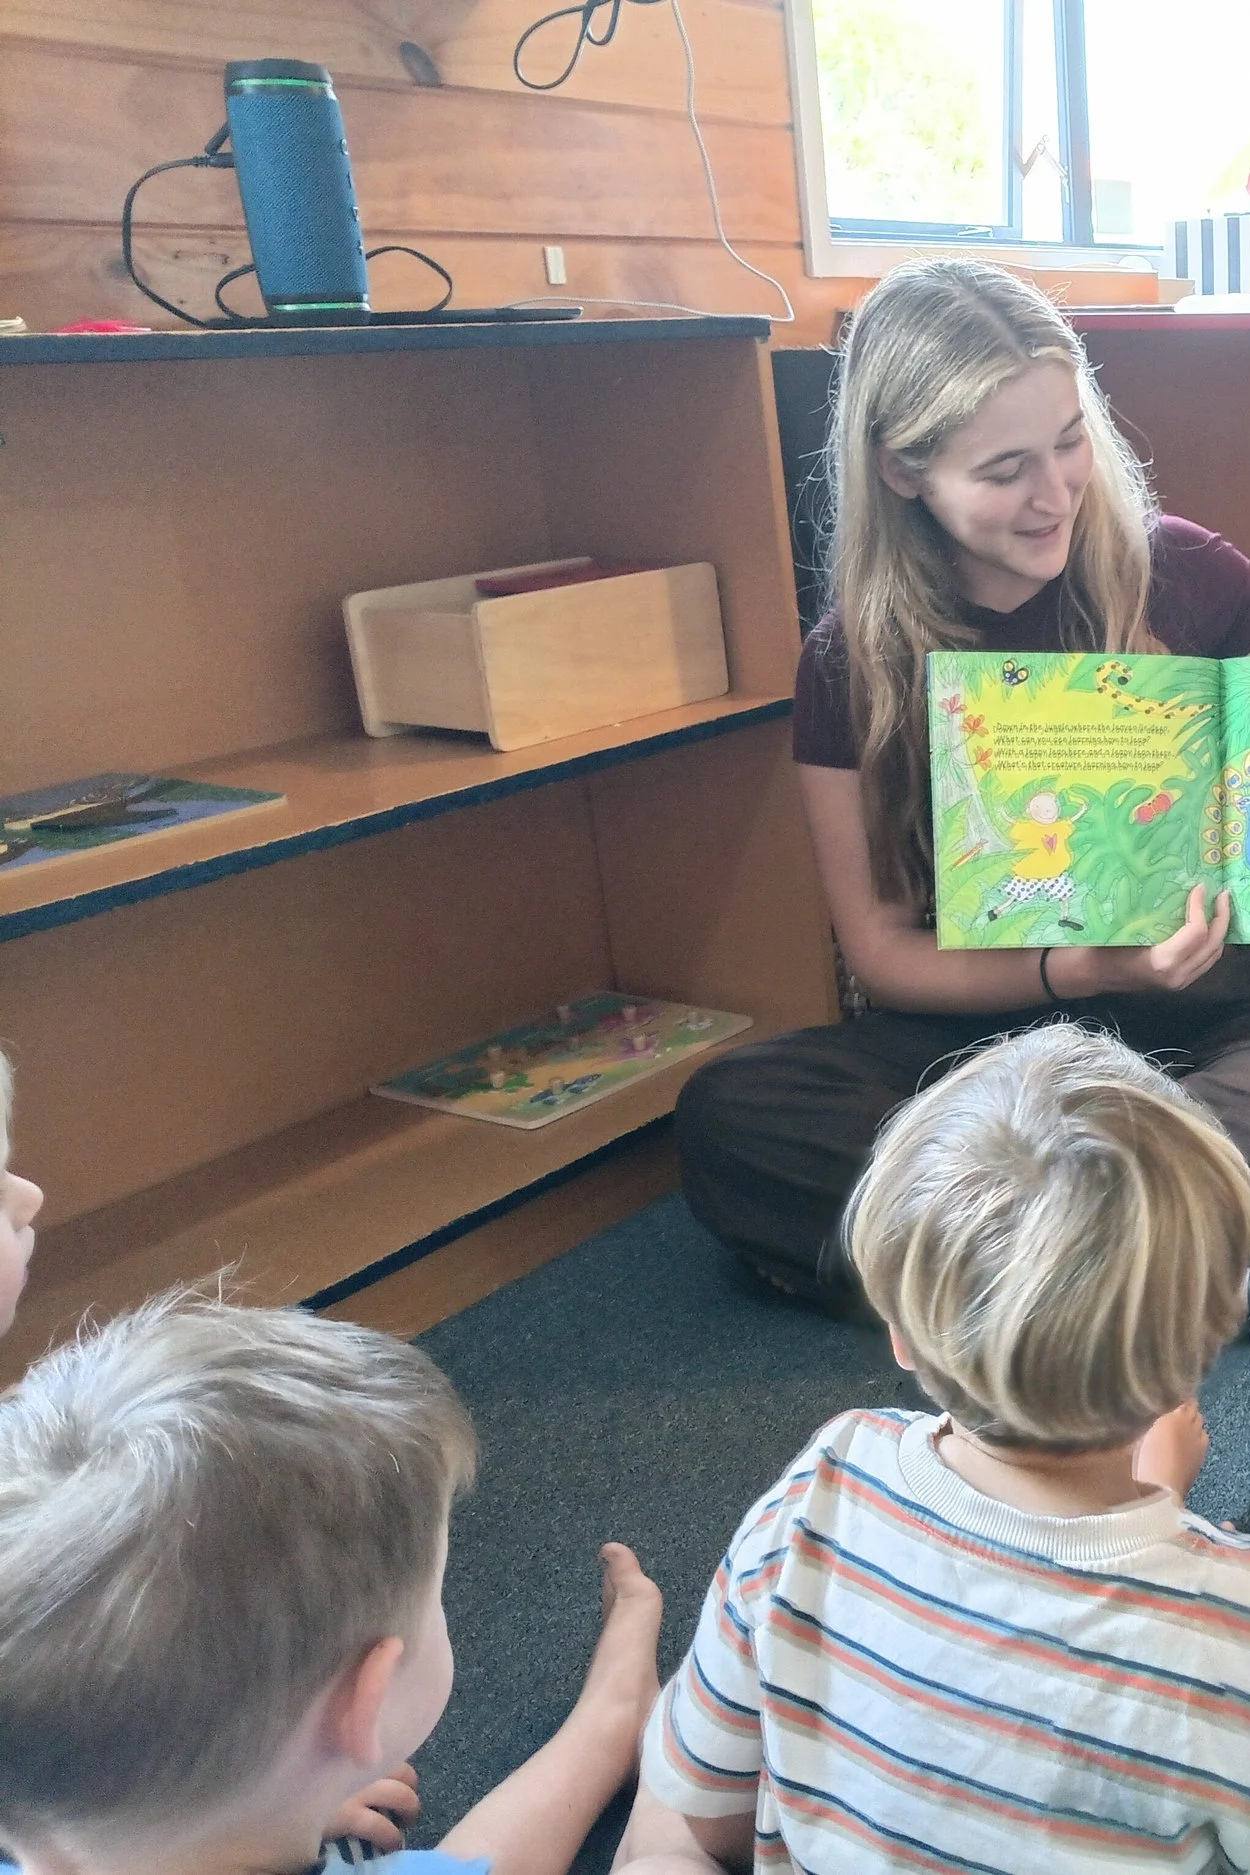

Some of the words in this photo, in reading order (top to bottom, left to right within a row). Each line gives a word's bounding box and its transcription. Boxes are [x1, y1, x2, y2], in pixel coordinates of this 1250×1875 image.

[994, 722, 1018, 733] Down
[1027, 722, 1043, 733] the
[1068, 722, 1095, 733] where
[994, 736, 1019, 745] What
[1034, 737, 1051, 746] you
[1066, 736, 1101, 746] learning
[1100, 736, 1119, 745] how
[995, 748, 1016, 757] With
[1065, 748, 1086, 758] here
[1085, 749, 1103, 758] and
[1026, 761, 1045, 770] that
[1044, 762, 1082, 770] creature
[1081, 761, 1116, 771] learning
[1115, 761, 1133, 771] how
